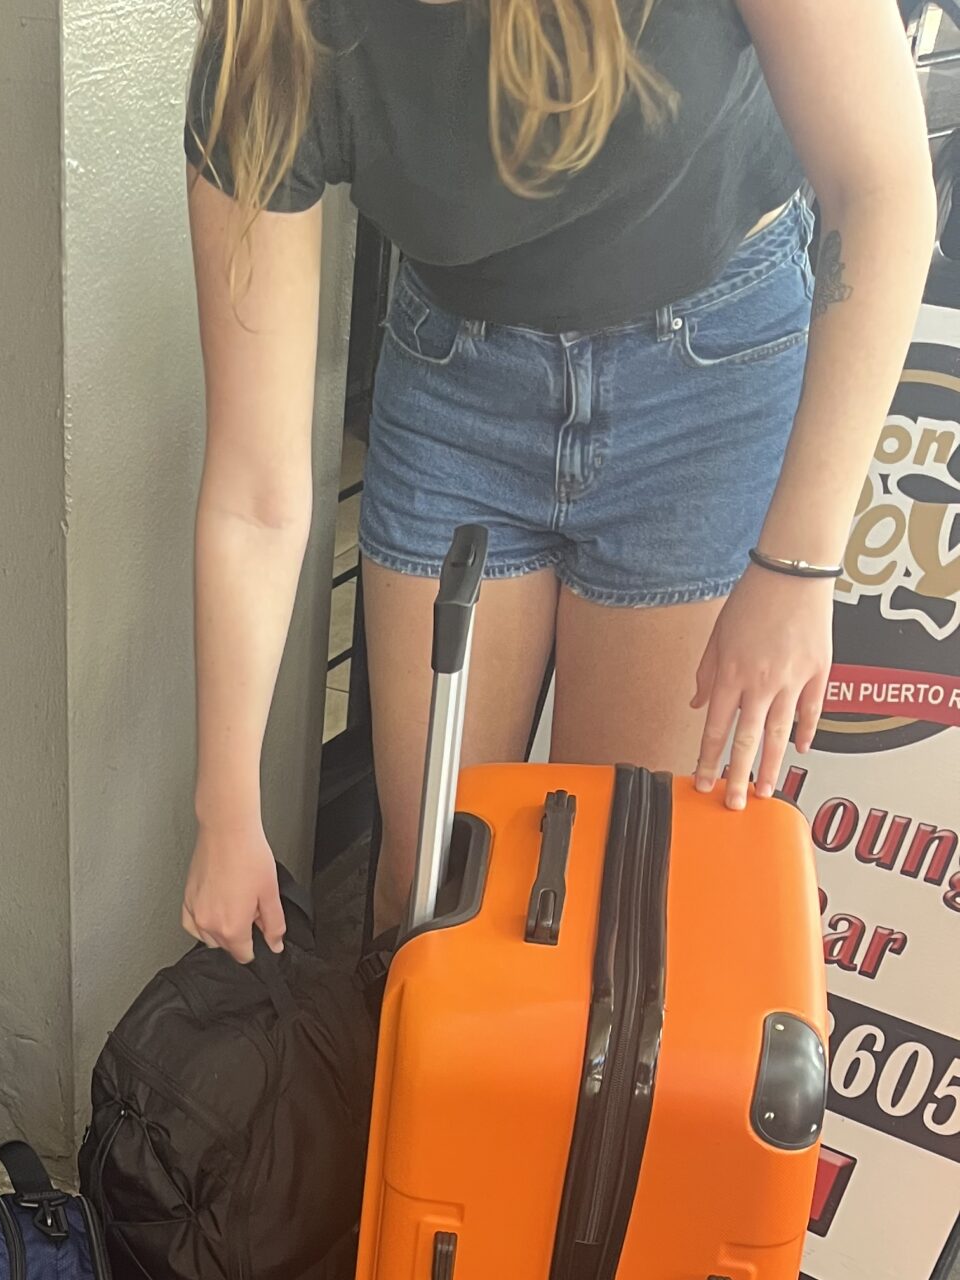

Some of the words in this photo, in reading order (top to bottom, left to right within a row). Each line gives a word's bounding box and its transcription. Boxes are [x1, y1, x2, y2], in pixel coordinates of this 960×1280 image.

[874, 424, 955, 466] on
[858, 683, 945, 705] PUERTO
[819, 887, 908, 980] ar
